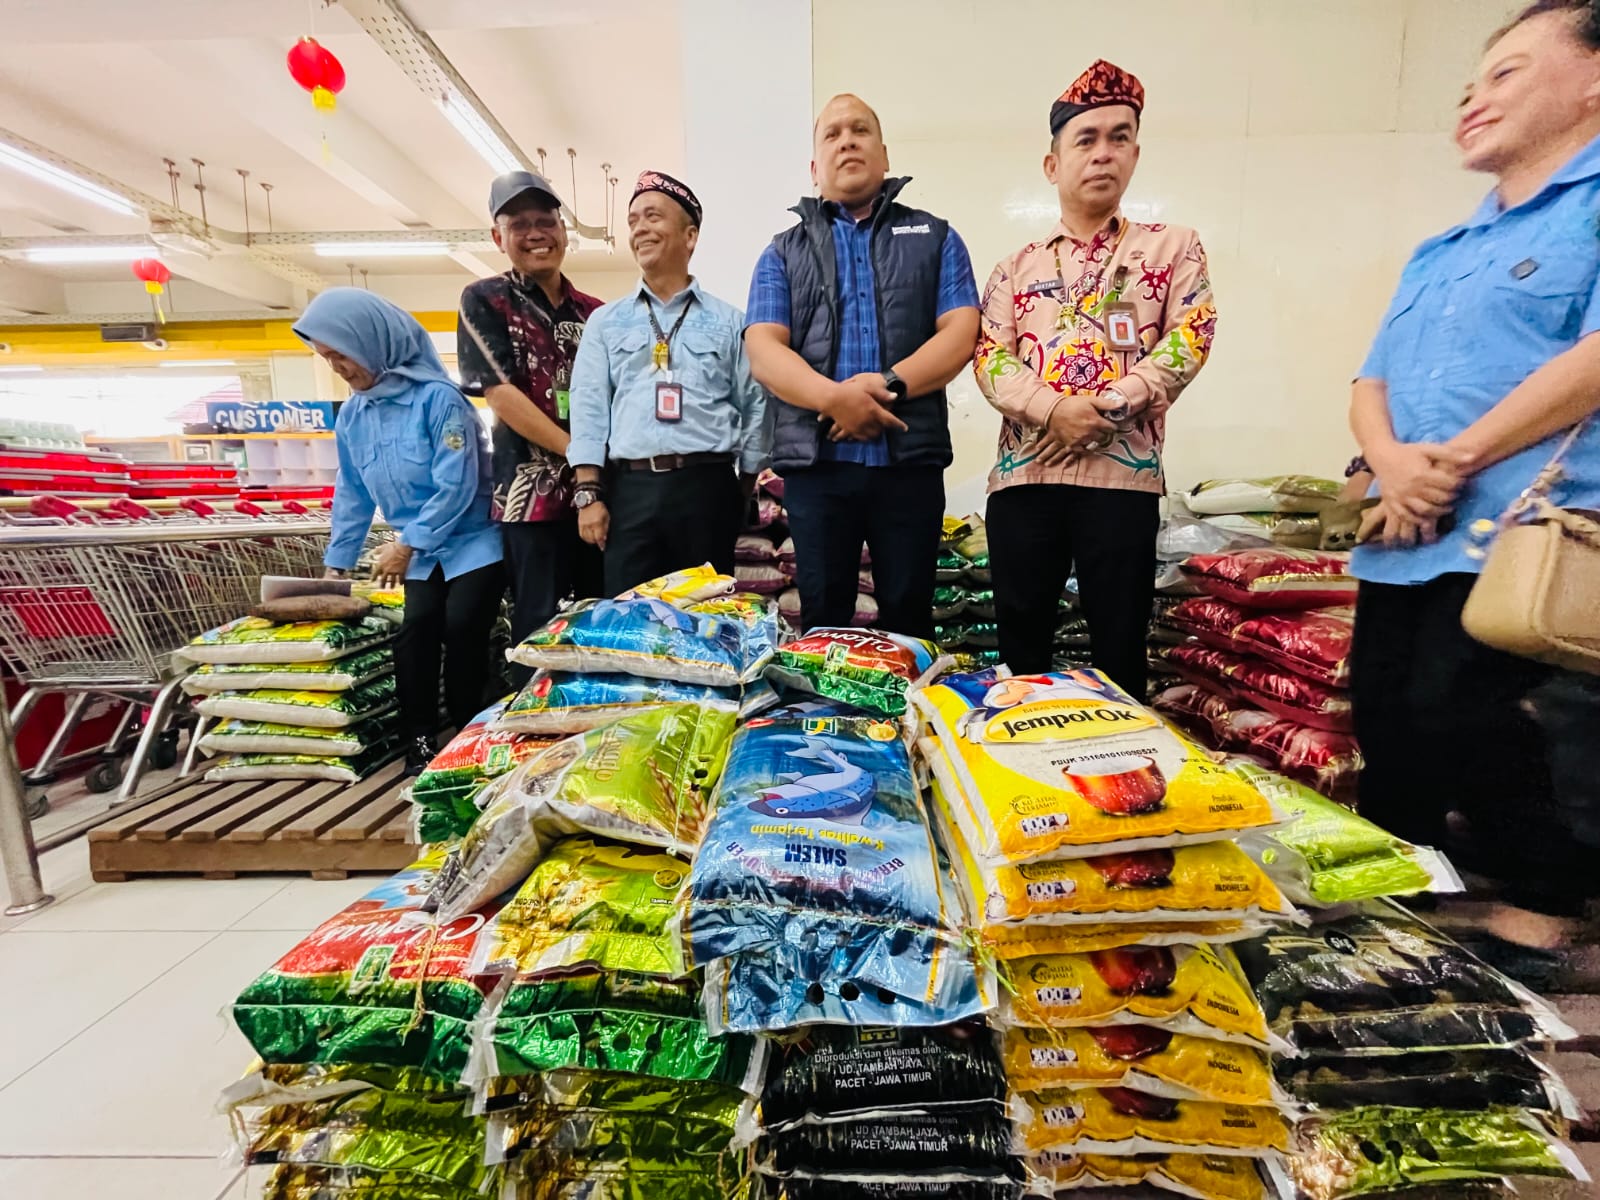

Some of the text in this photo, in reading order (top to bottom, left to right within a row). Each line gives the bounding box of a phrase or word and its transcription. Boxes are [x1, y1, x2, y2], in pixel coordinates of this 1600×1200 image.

[215, 409, 326, 429] CUSTOMER
[1002, 710, 1094, 738] Jempol
[751, 823, 815, 840] Terjamin
[784, 843, 848, 867] SALEM
[883, 1046, 920, 1058] dikemas
[922, 1045, 941, 1054] oleh
[858, 1060, 897, 1074] TAMBAH
[835, 1077, 866, 1089] PACET
[874, 1074, 901, 1086] JAWA
[902, 1071, 932, 1083] TIMUR
[874, 1125, 913, 1136] TAMBAH
[850, 1139, 880, 1150] PACET
[889, 1140, 917, 1151] JAWA
[918, 1140, 949, 1152] TIMUR
[896, 1183, 921, 1192] JAWA
